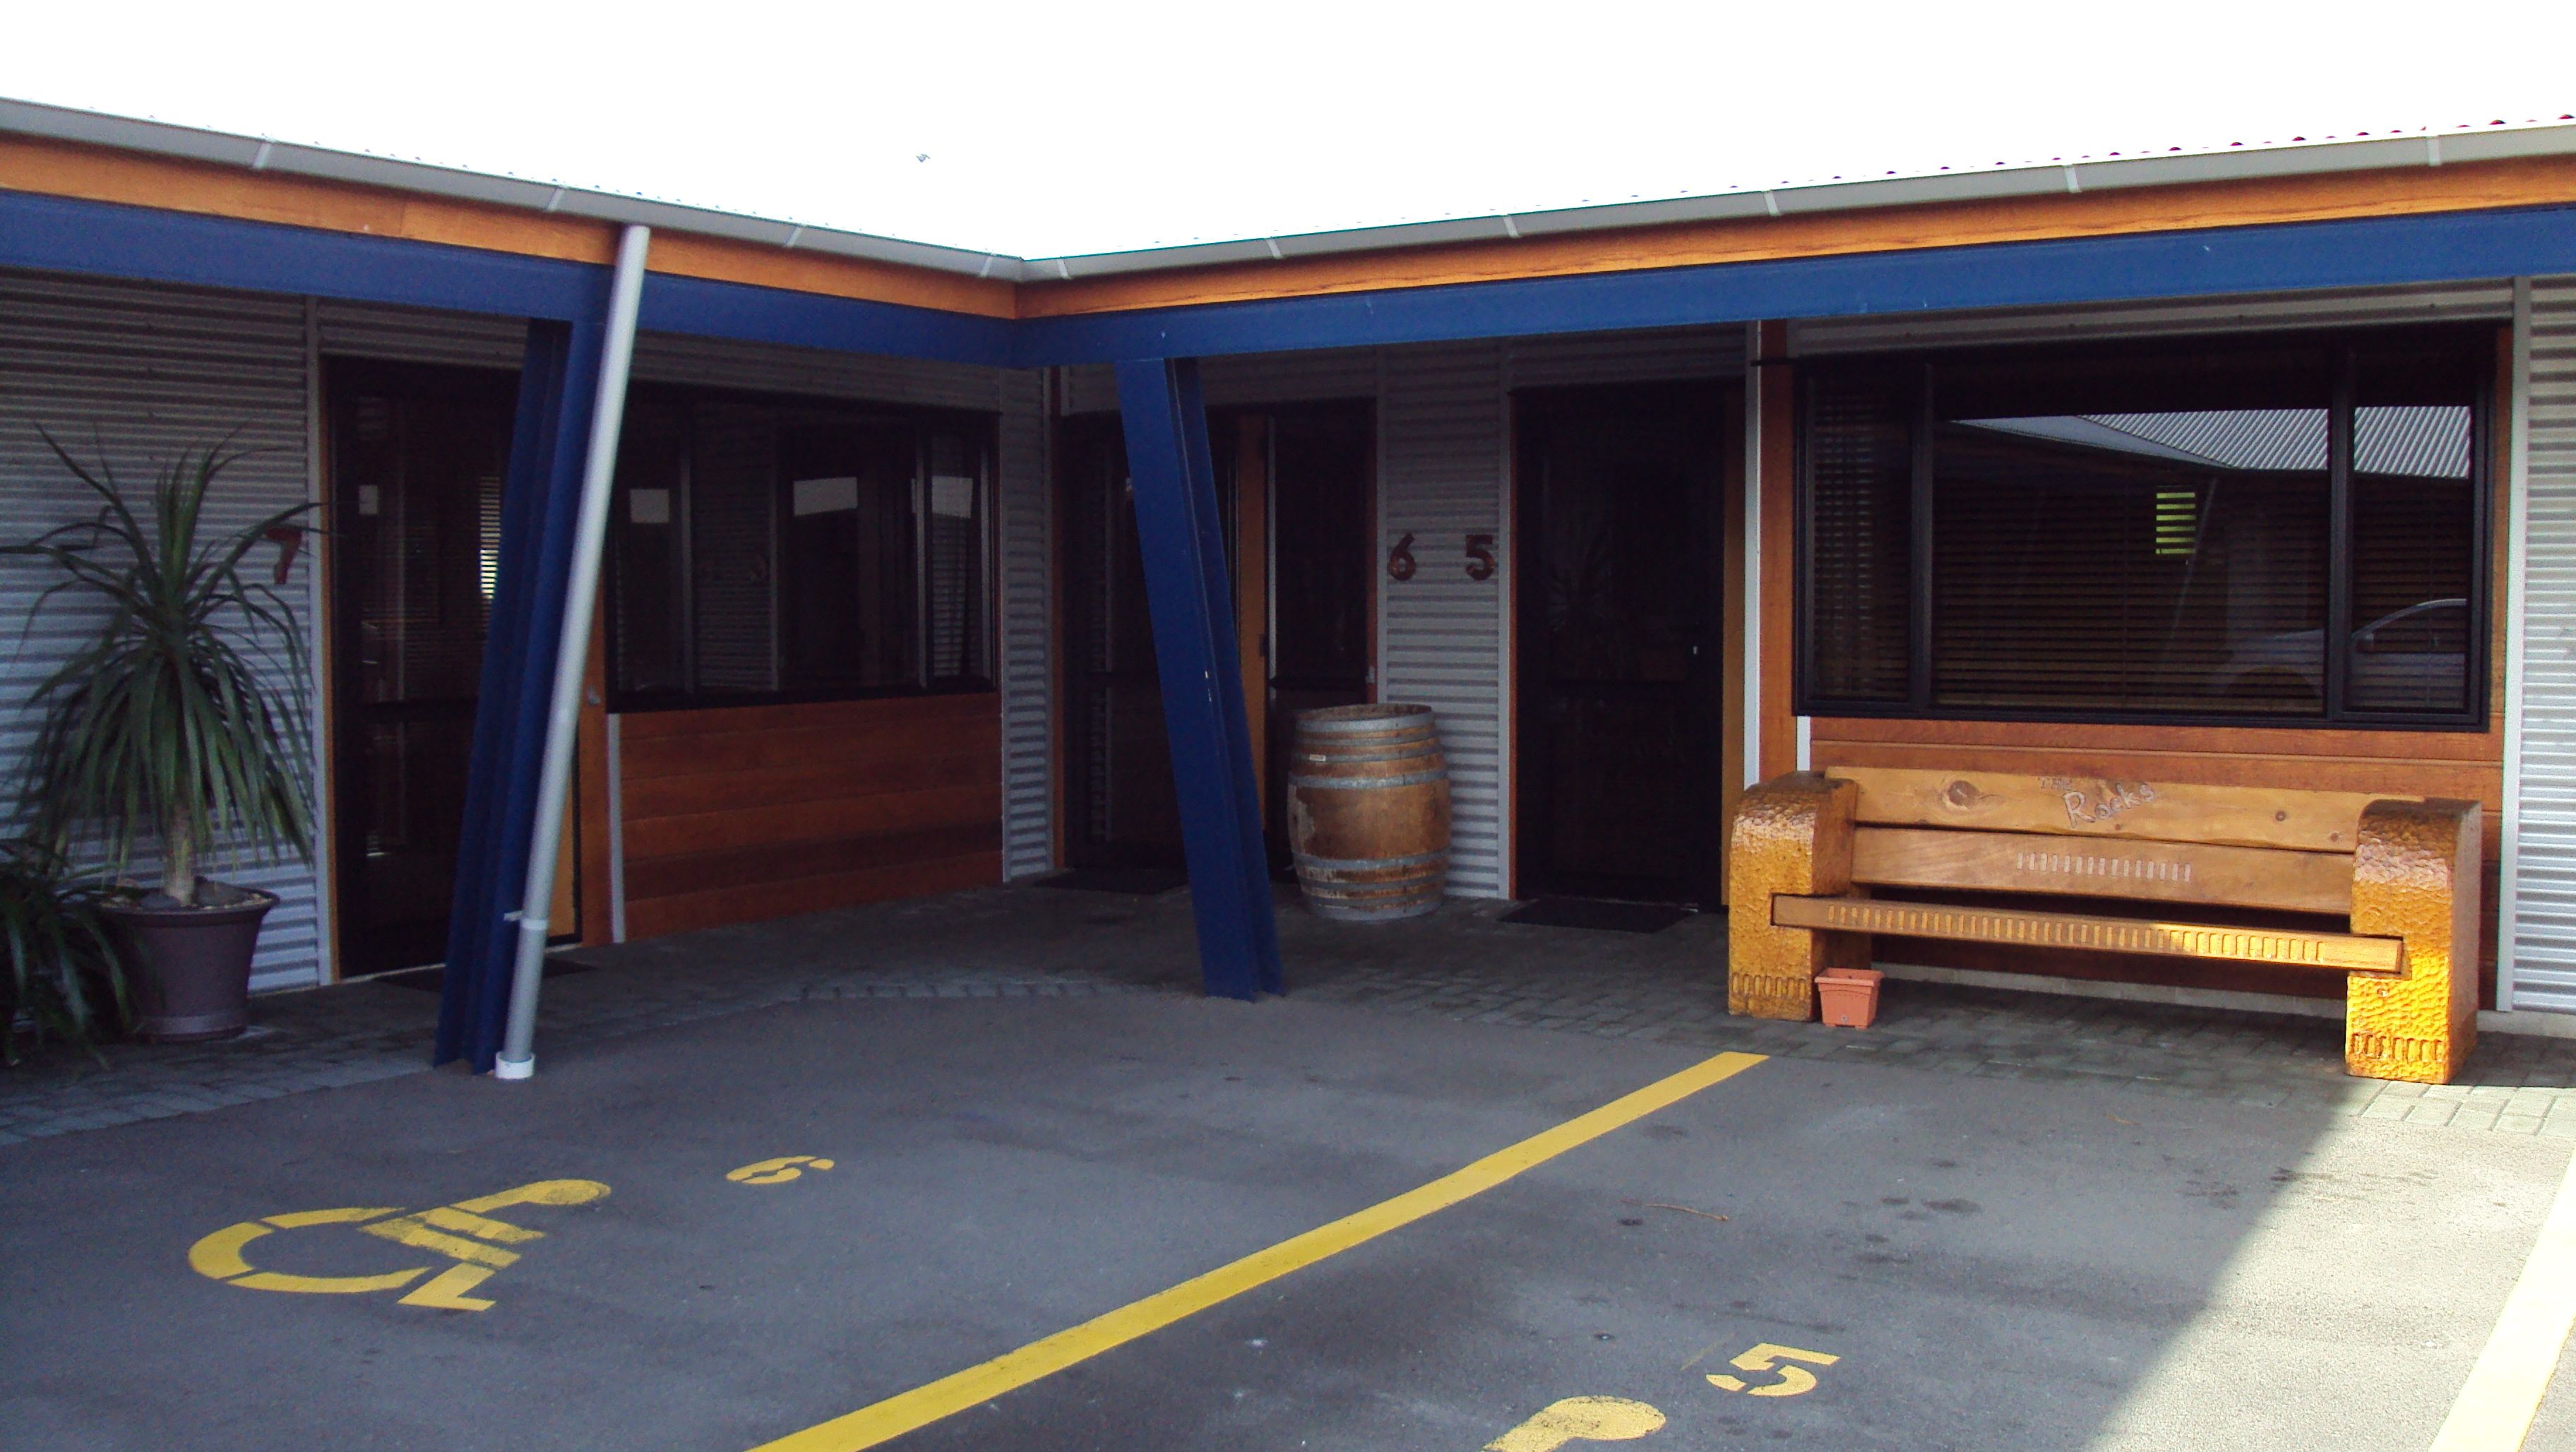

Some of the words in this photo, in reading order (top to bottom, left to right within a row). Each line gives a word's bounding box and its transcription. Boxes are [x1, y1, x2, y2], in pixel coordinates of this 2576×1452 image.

[266, 524, 302, 585] 7
[1388, 532, 1416, 581] 6
[1465, 534, 1496, 581] 5
[2063, 781, 2154, 828] Rocks
[727, 1155, 835, 1184] 6
[1705, 1343, 1841, 1396] 5
